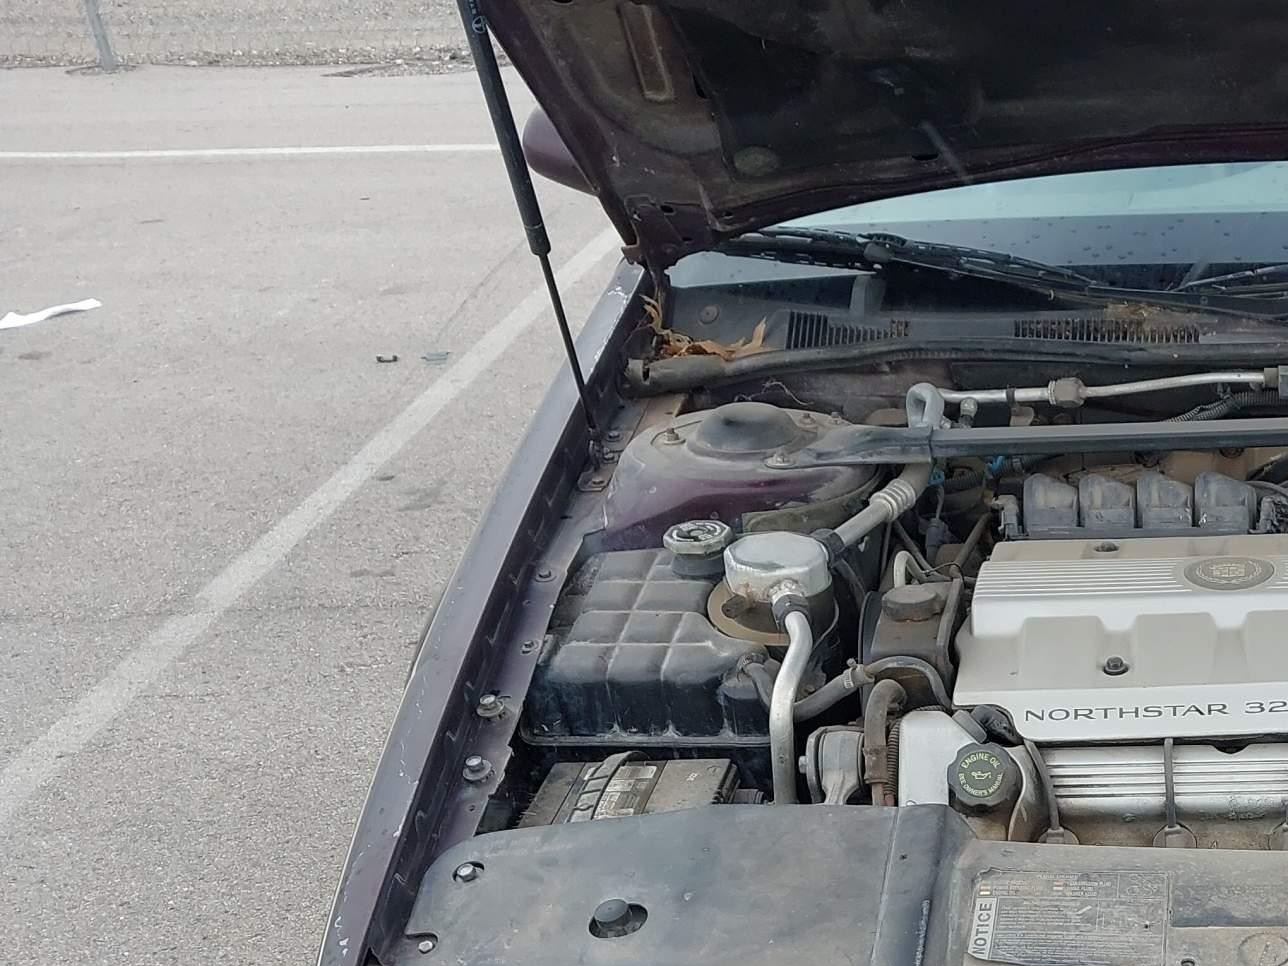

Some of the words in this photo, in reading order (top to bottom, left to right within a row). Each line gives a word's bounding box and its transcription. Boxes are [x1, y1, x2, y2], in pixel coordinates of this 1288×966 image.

[1025, 703, 1230, 722] NORTHSTAR
[1244, 700, 1288, 714] 32
[961, 753, 989, 768] ENGINE
[989, 757, 1001, 769] OIL
[987, 773, 1004, 794] MANUAL
[971, 902, 993, 955] NOTICE
